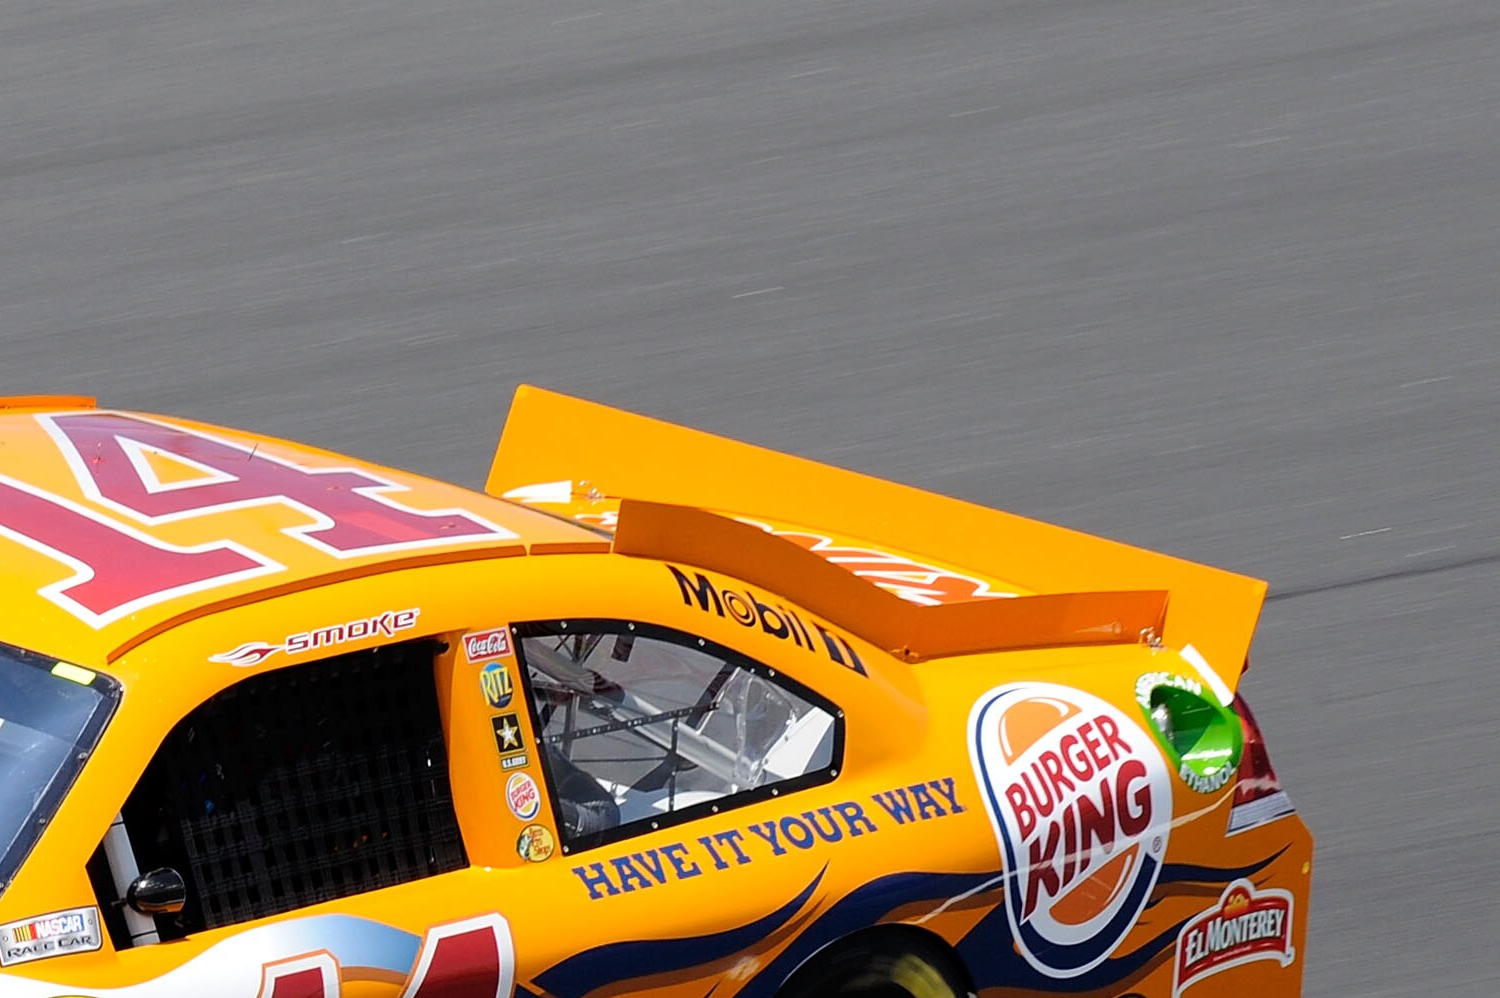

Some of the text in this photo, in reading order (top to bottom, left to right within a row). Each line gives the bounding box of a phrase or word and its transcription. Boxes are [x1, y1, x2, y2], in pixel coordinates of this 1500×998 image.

[665, 564, 815, 652] Mobil
[481, 667, 512, 705] RITZ
[514, 788, 535, 812] KING
[1005, 714, 1132, 843] BURGER
[573, 777, 967, 899] HAVE IT YOUR WAY
[1019, 759, 1153, 924] KING
[57, 934, 94, 949] CAR
[1184, 908, 1286, 969] EL MONTEREY
